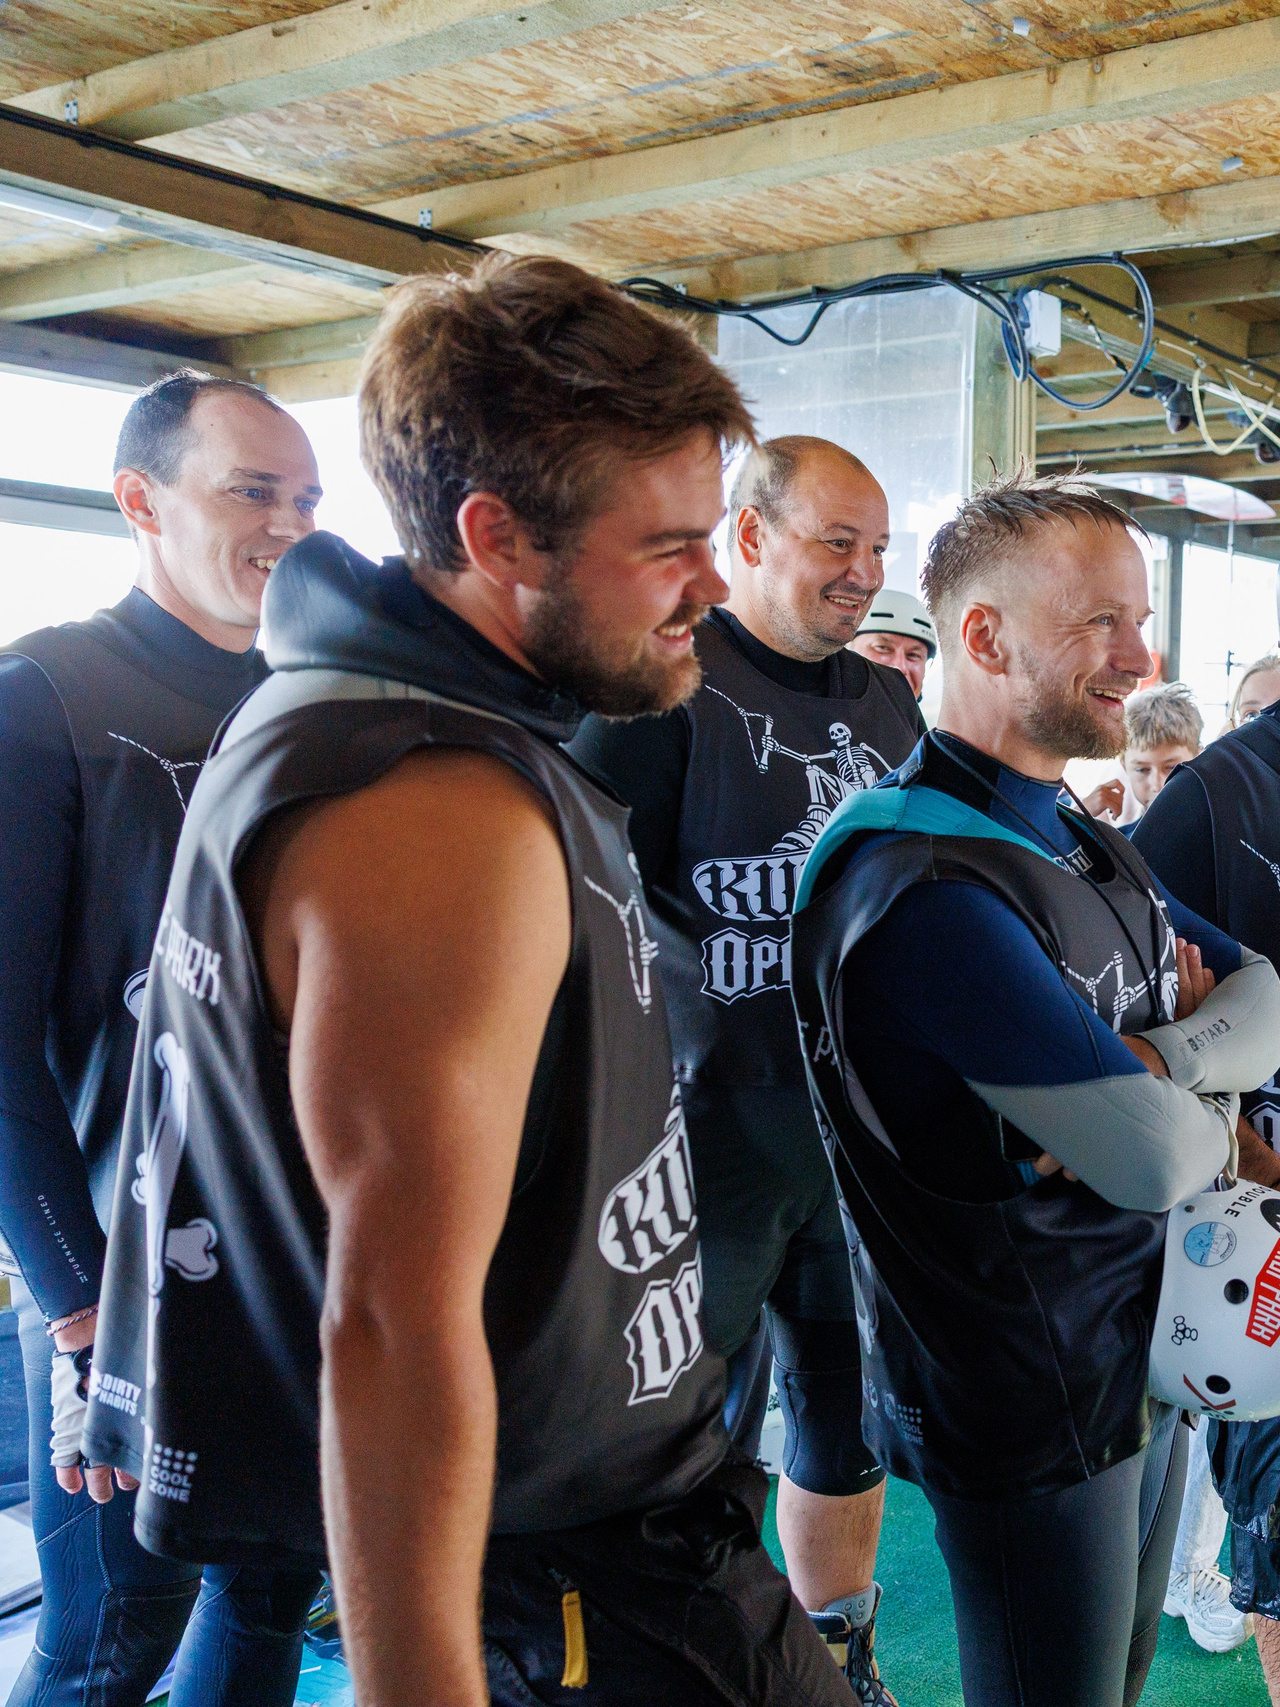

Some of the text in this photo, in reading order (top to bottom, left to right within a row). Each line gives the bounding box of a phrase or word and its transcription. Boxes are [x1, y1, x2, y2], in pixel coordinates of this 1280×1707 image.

[37, 1194, 84, 1276] FURNACE LINED
[102, 1373, 142, 1403] DIRTY
[98, 1389, 138, 1417] HABITS
[149, 1478, 190, 1504] ZONE
[150, 1465, 192, 1489] COOL
